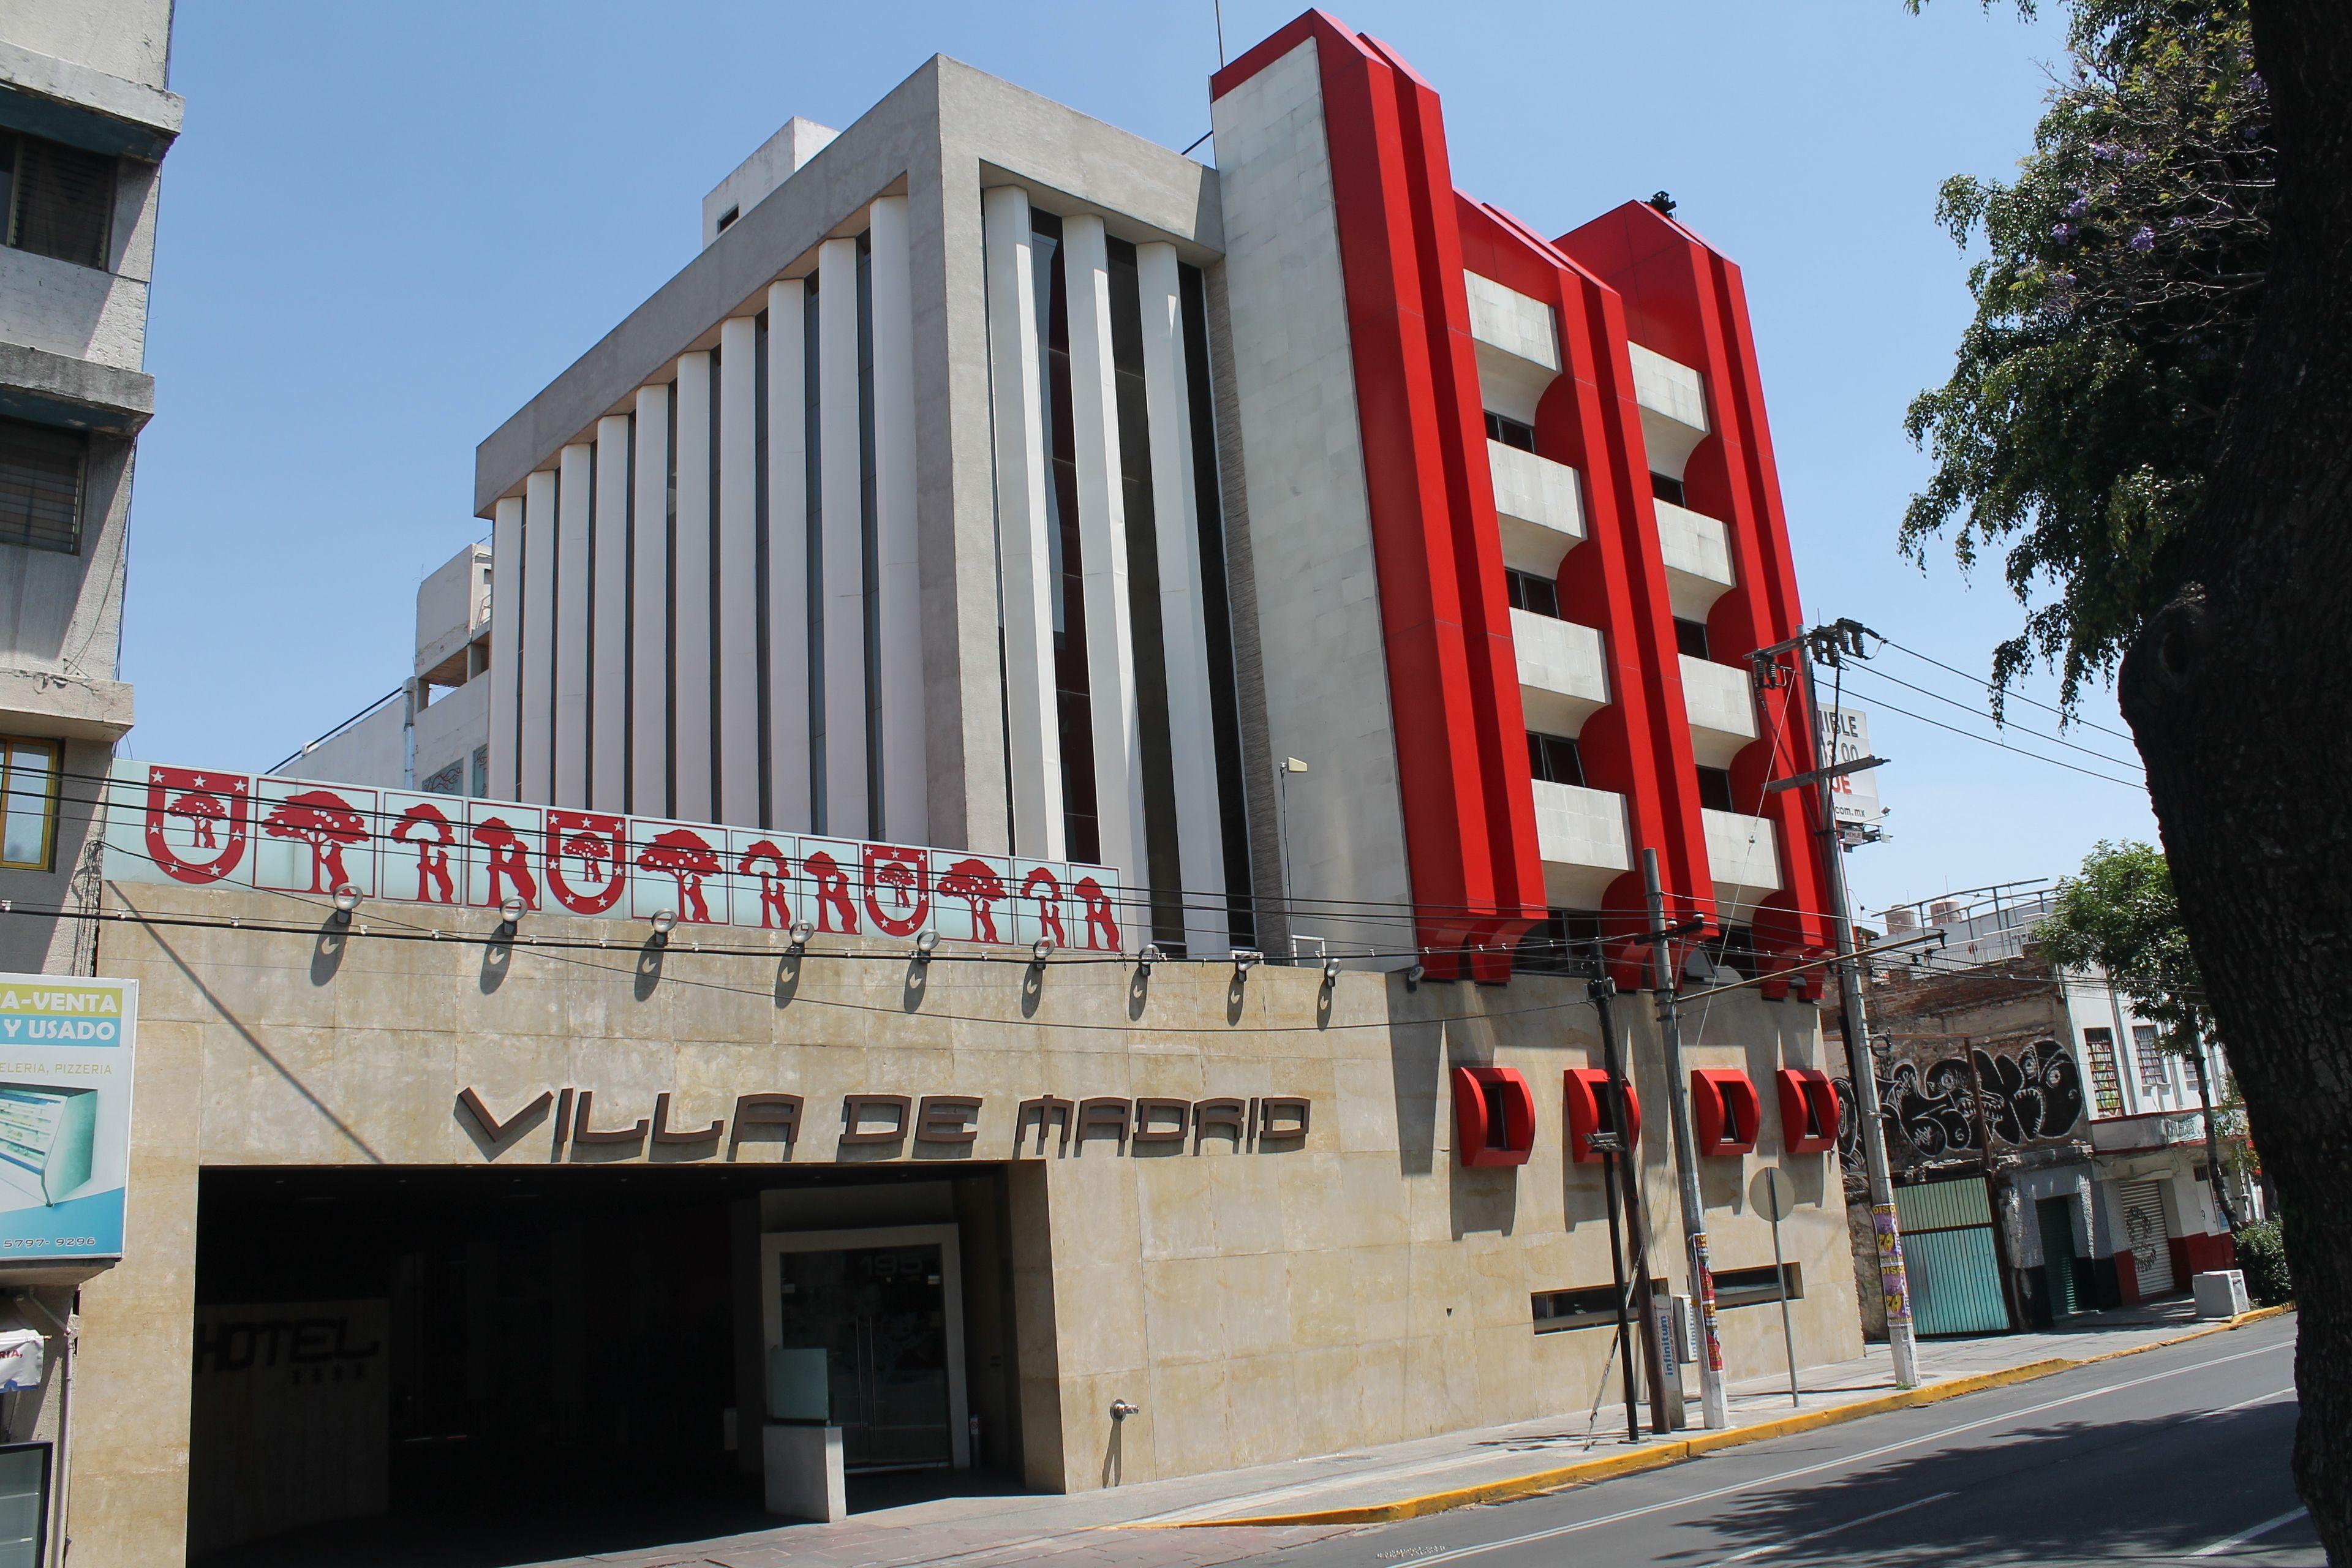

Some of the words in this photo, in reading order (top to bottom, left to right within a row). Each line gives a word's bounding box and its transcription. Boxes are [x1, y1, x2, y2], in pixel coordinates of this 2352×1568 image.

[0, 990, 118, 1013] A-VENTA
[4, 1019, 21, 1037] Y
[28, 1019, 115, 1040] USADO
[55, 1063, 112, 1075] PIZZERIA
[456, 1088, 804, 1144] VILLA
[840, 1094, 982, 1143] DE
[1015, 1093, 1311, 1142] MADRID
[1872, 1205, 1897, 1215] DISC
[2201, 1210, 2206, 1221] 9
[4, 1239, 50, 1248] 5797-
[56, 1237, 96, 1246] 9296
[862, 1254, 922, 1276] 195
[1882, 1265, 1905, 1275] DISC
[195, 1316, 380, 1374] HOTEL
[1660, 1315, 1673, 1376] infinitum
